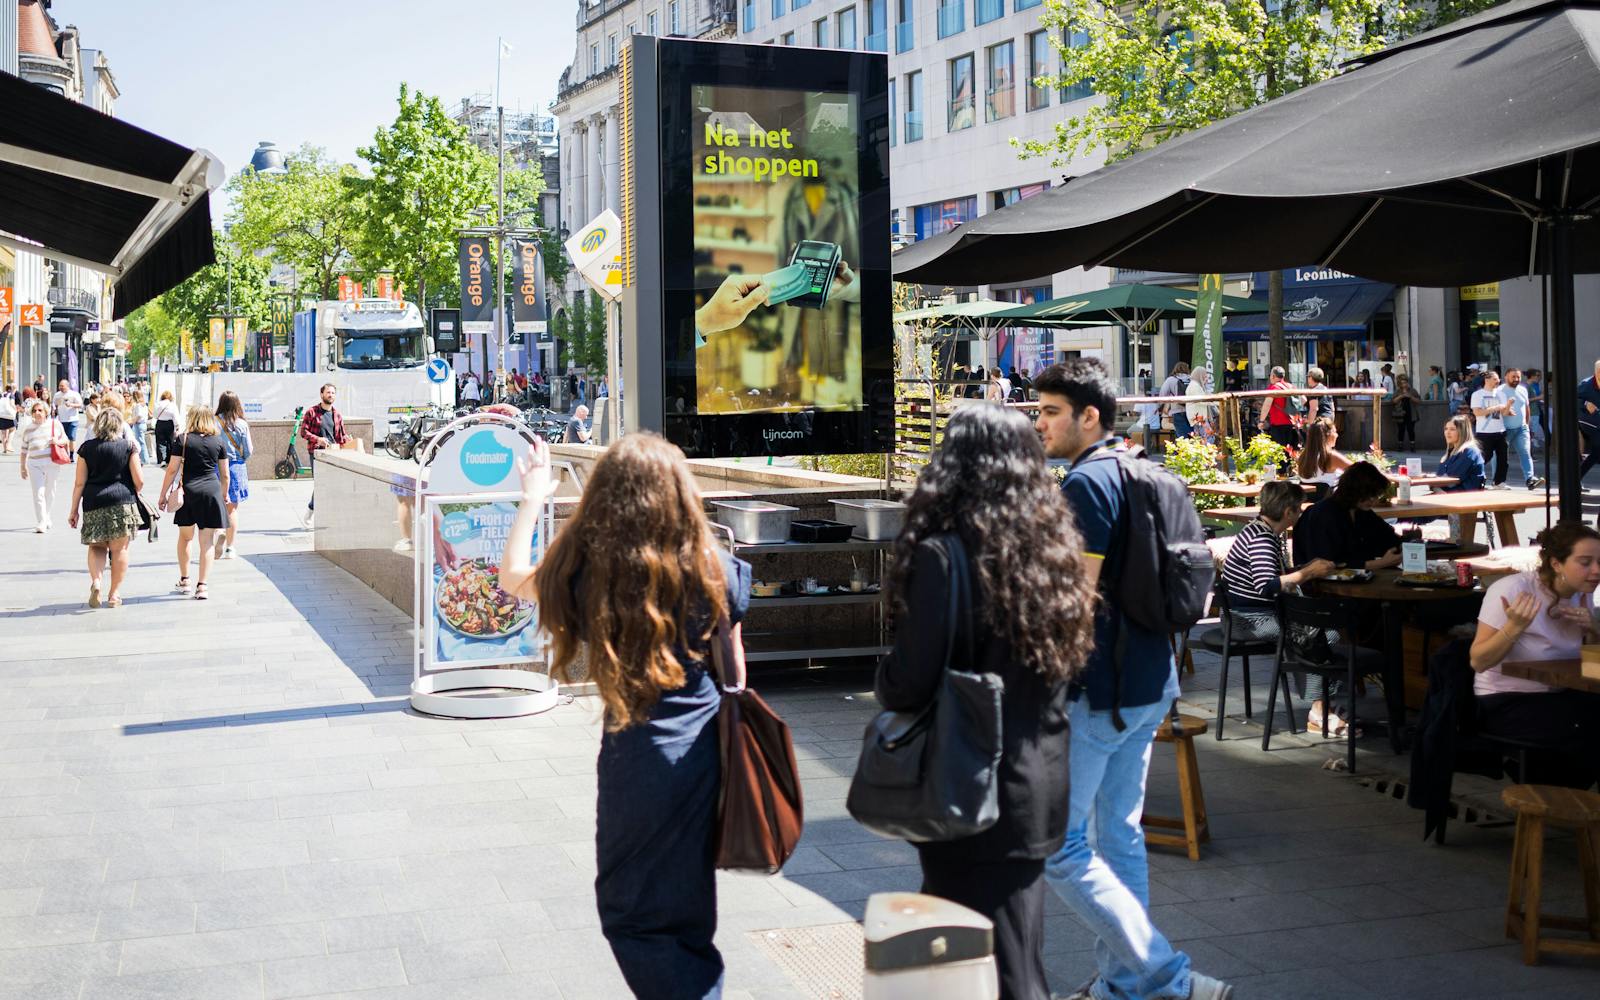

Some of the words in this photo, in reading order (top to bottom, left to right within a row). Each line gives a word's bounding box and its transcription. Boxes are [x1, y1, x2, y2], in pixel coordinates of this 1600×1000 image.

[705, 123, 740, 147] Na
[749, 123, 794, 149] het
[705, 150, 818, 183] shoppen
[467, 243, 483, 306] Orange
[521, 242, 537, 306] Orange
[1295, 268, 1356, 282] Leonida
[762, 428, 804, 441] Lijncom
[473, 512, 502, 526] FROM
[504, 512, 519, 525] OU
[479, 540, 492, 552] TO
[493, 539, 507, 552] YO
[484, 552, 503, 564] TAB
